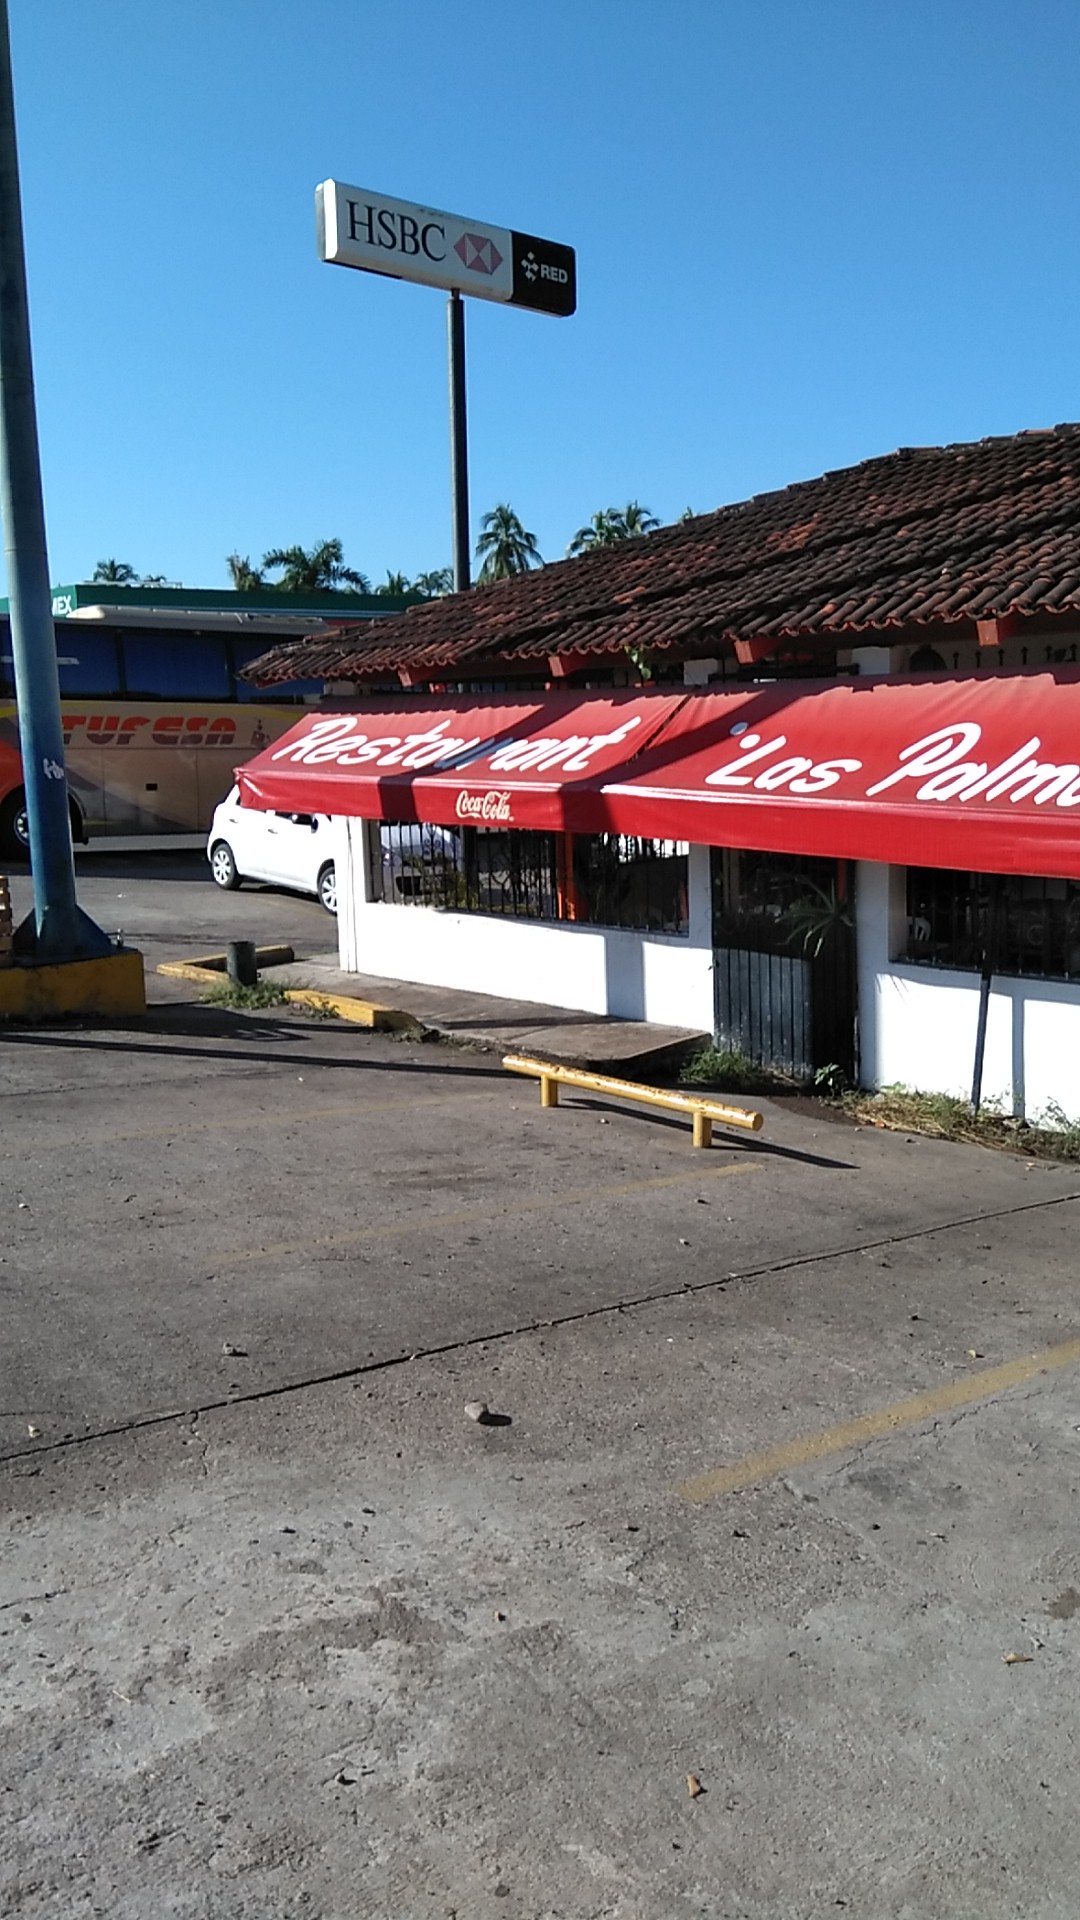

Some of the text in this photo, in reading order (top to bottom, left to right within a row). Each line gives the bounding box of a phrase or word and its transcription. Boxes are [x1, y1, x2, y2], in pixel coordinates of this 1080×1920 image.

[346, 200, 447, 262] HSBC
[540, 266, 568, 284] RED
[62, 715, 237, 745] TUFESA
[272, 716, 641, 772] Restaurant
[456, 790, 512, 820] Coca-Cola
